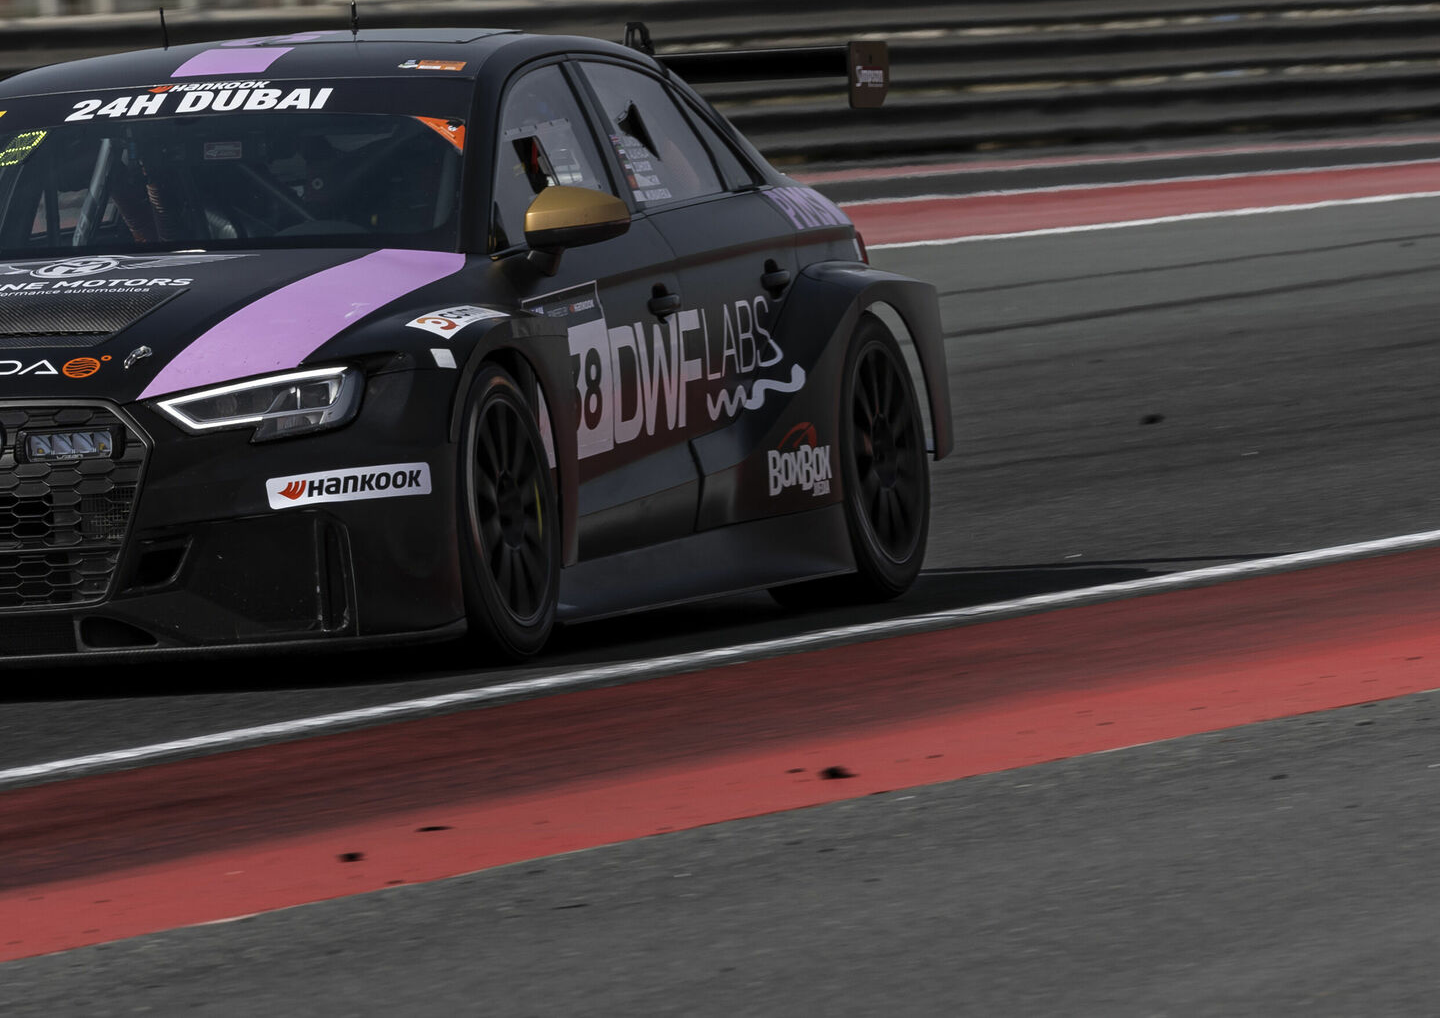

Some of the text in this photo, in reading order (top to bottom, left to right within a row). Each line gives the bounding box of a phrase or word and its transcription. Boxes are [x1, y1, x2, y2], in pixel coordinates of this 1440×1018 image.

[64, 88, 334, 122] 24H DUBAI
[52, 278, 194, 289] MOTORS
[63, 286, 151, 294] automobiles
